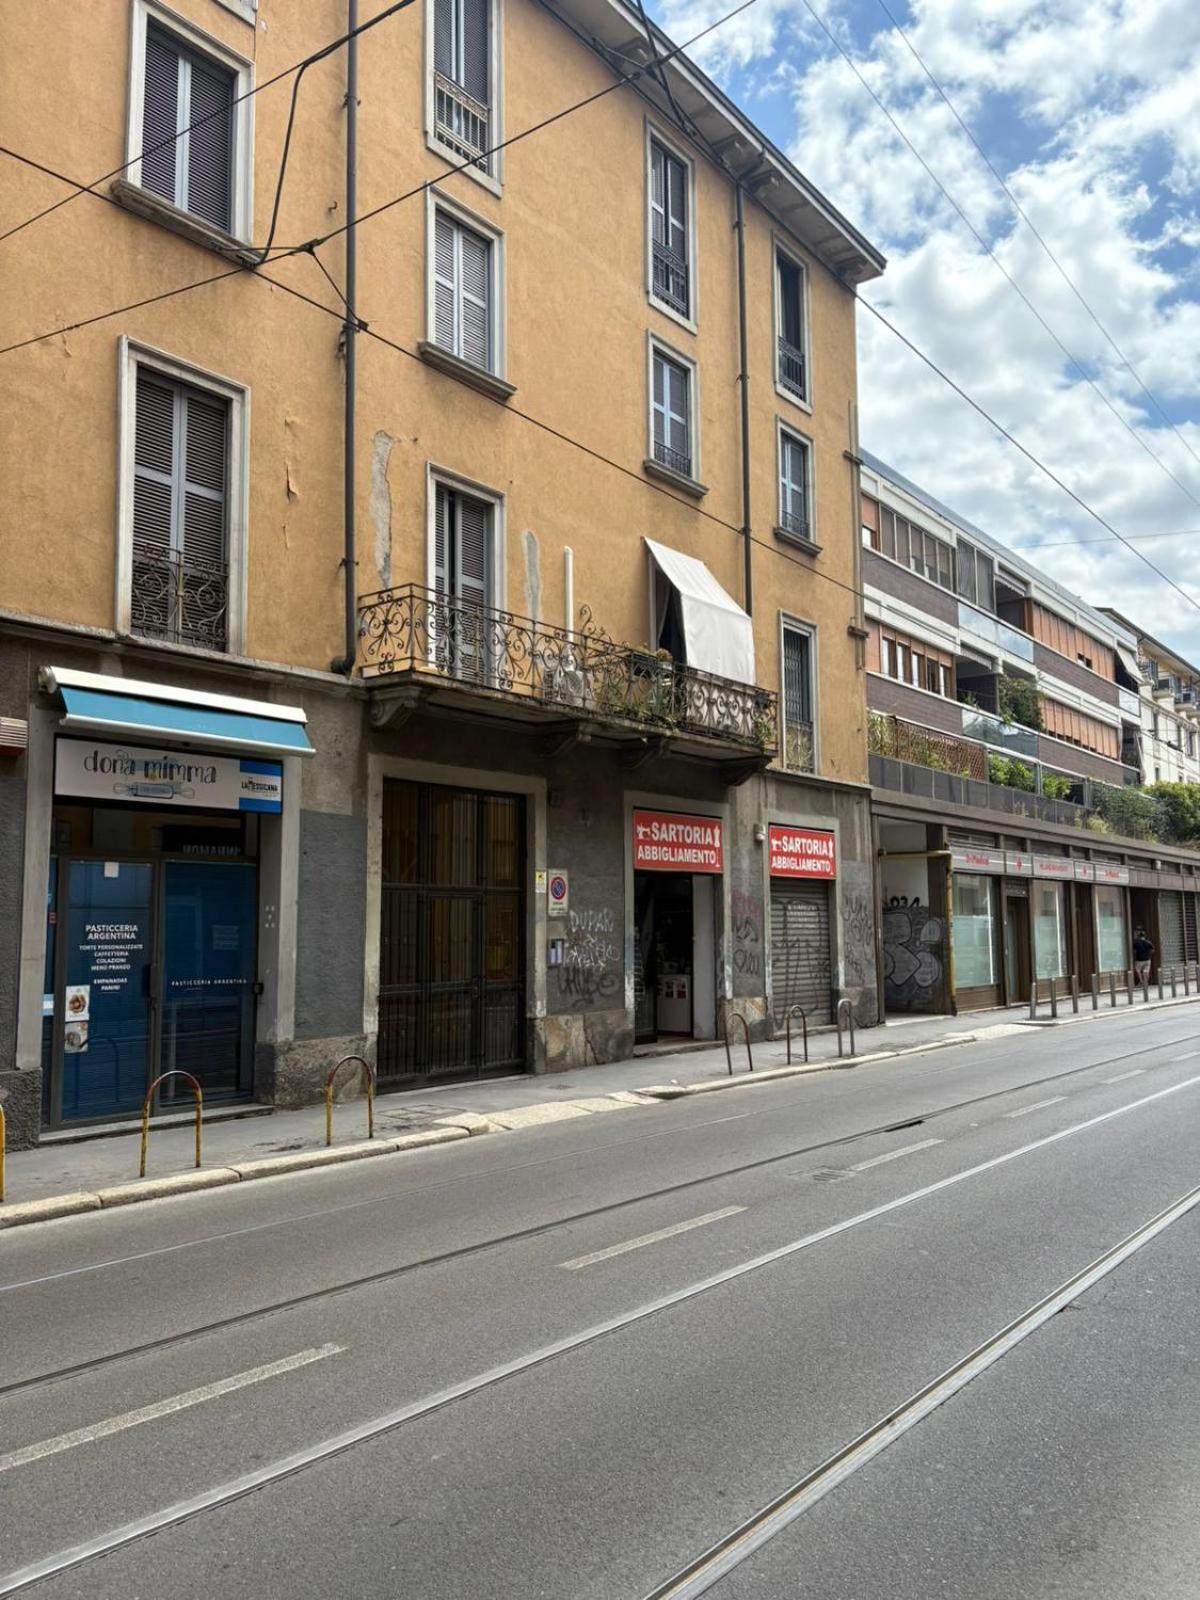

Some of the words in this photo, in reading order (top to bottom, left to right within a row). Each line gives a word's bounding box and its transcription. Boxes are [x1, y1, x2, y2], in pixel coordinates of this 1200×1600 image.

[143, 756, 217, 784] mimma
[651, 822, 712, 845] SARTORIA
[637, 845, 716, 864] ABBIGLIAMENTO
[782, 837, 828, 856] SARTORIA
[771, 856, 831, 873] ABBIGLIAMENTO
[85, 924, 138, 932] PASTICCERIA
[87, 932, 136, 940] ARGENTINA
